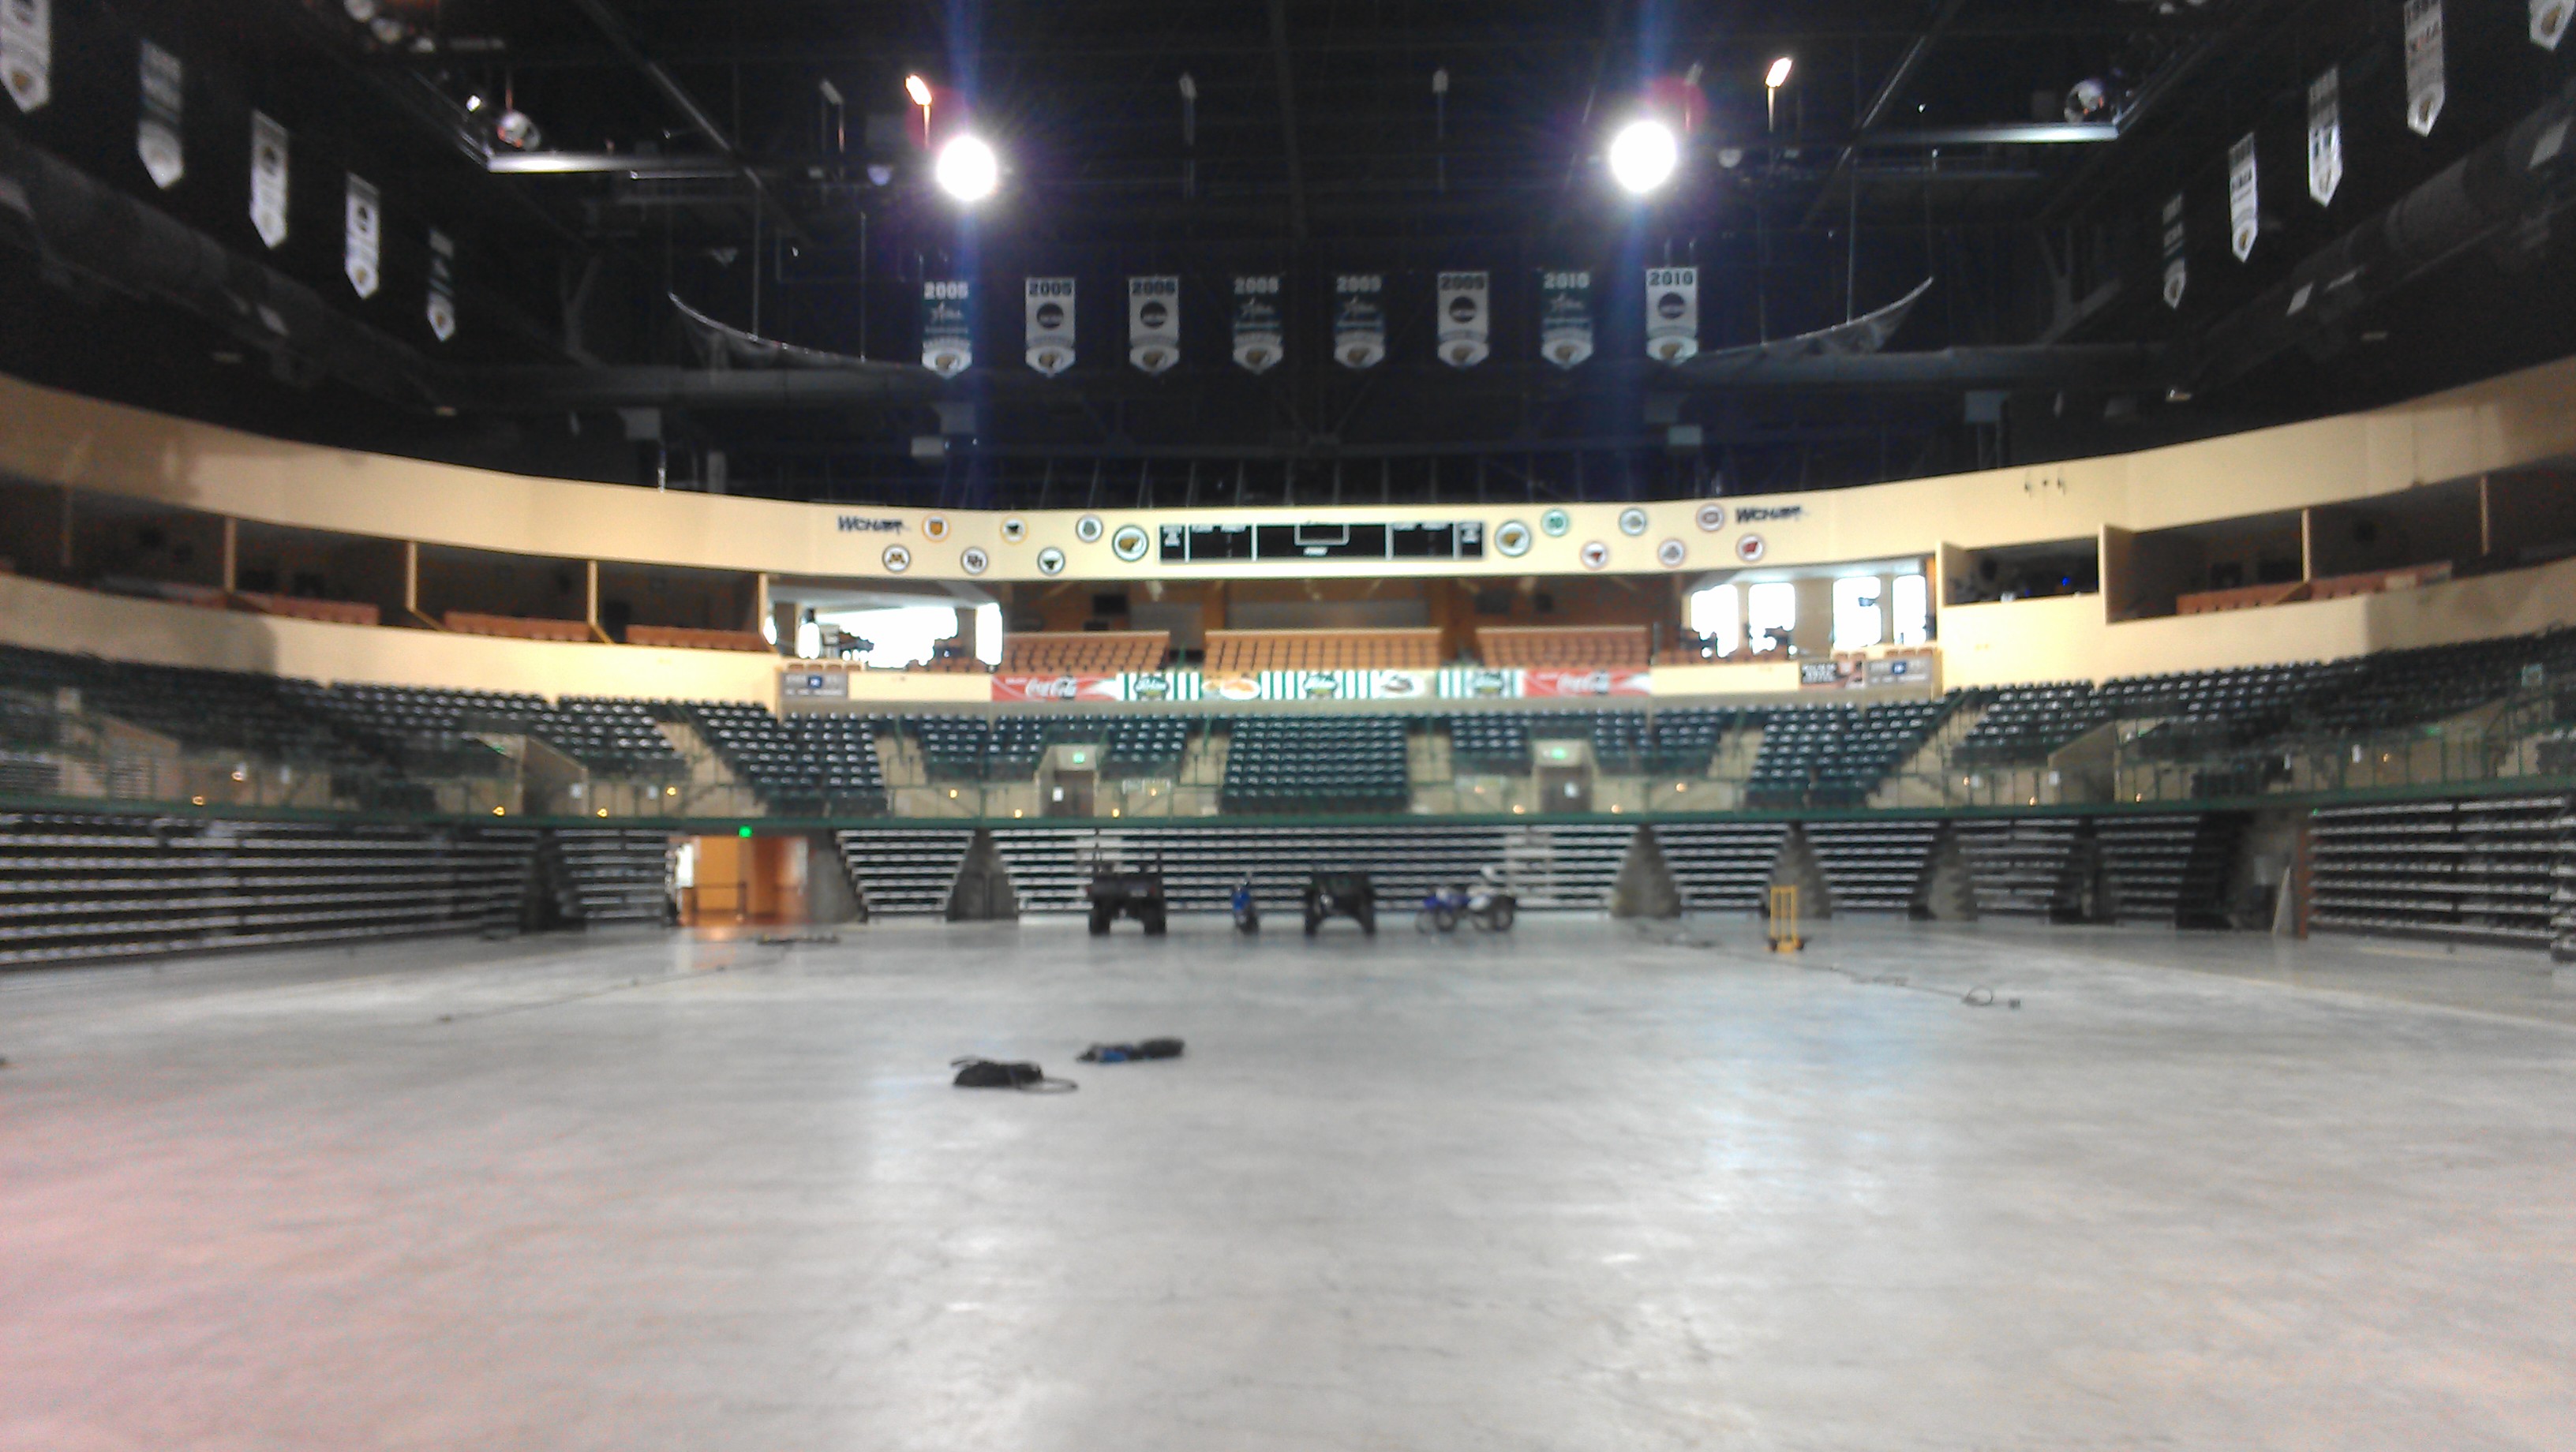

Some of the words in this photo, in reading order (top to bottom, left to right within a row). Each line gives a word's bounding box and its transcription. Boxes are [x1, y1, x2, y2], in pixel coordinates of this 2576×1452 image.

[1234, 277, 1278, 295] 200
[1544, 272, 1589, 289] 2010
[1649, 270, 1694, 286] 2010
